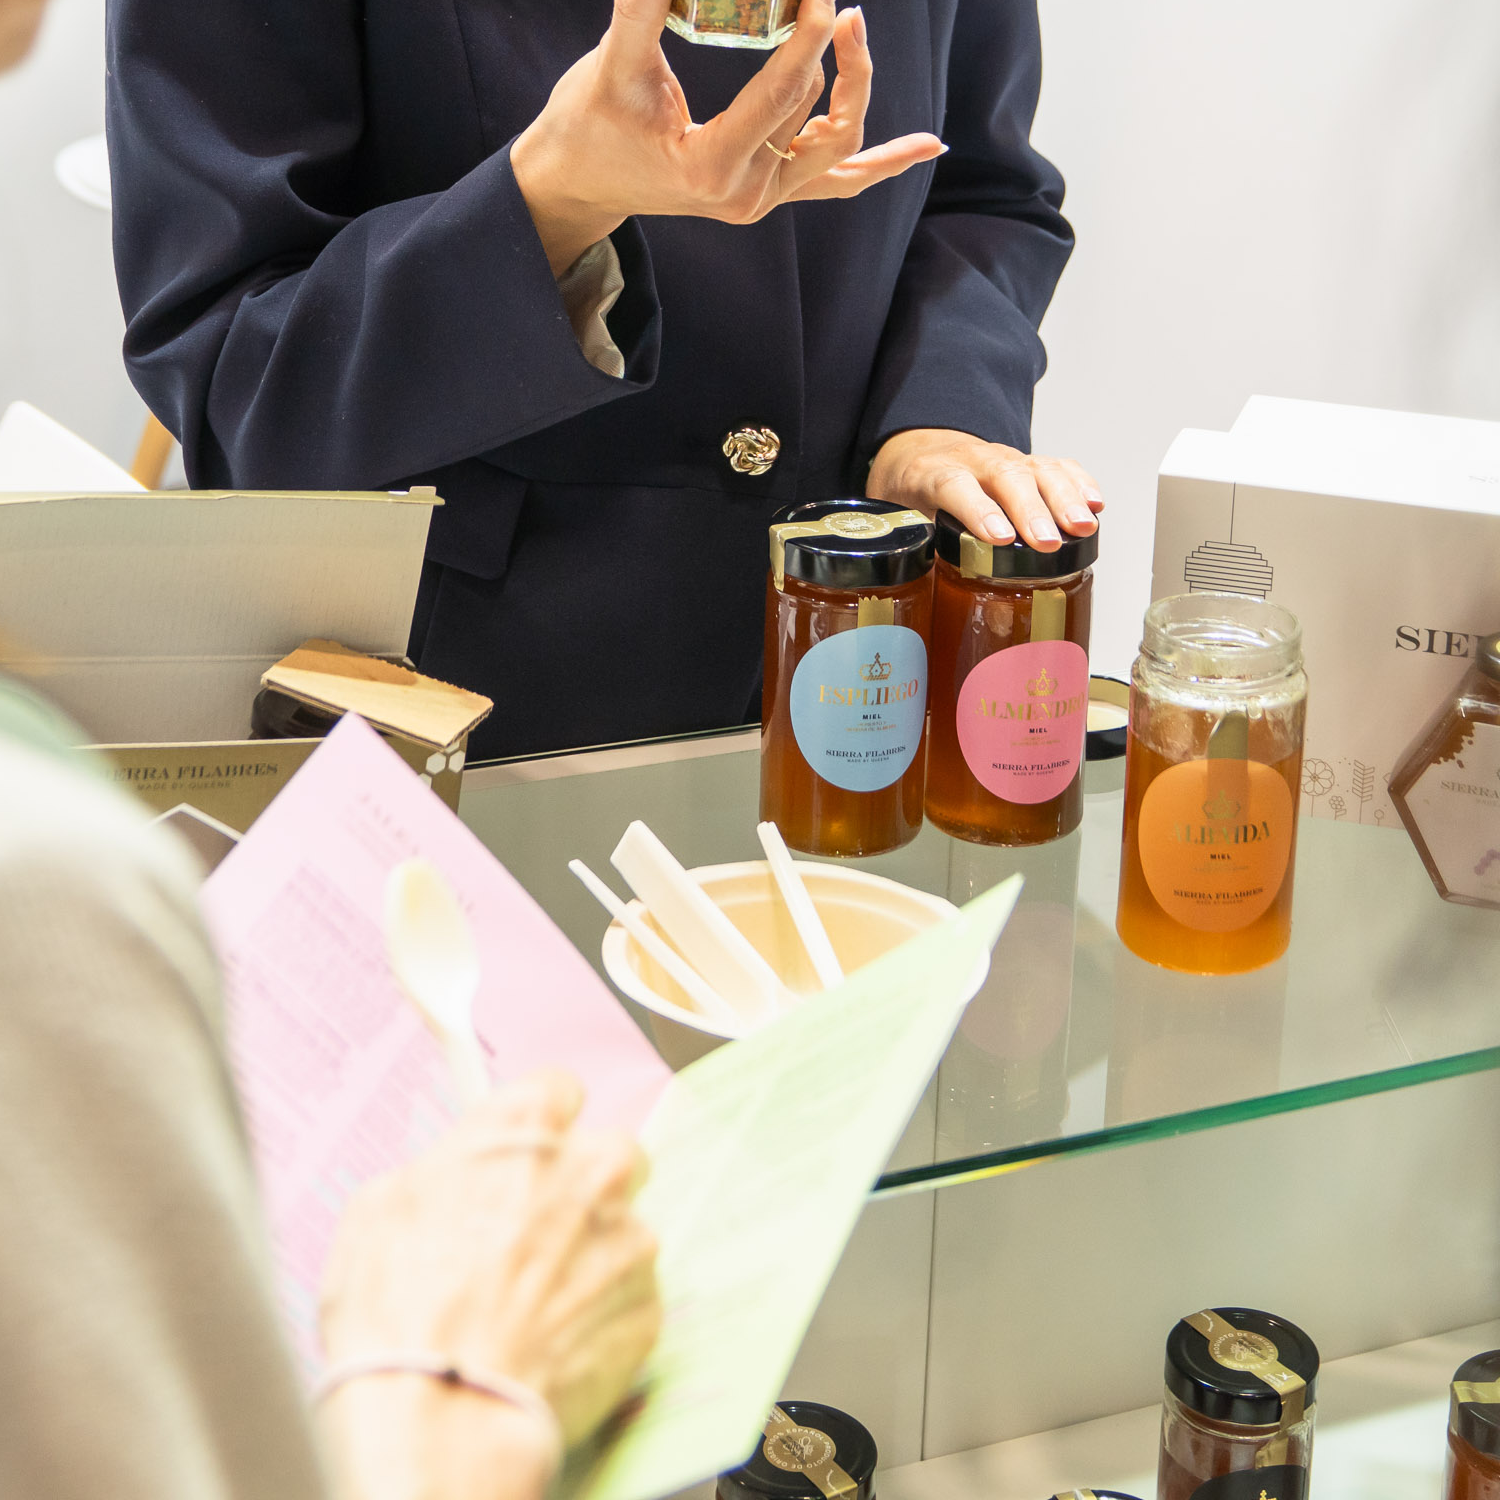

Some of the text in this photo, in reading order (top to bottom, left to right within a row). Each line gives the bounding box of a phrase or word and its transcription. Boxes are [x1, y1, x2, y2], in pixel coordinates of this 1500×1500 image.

[818, 678, 919, 707] ESPLIEGO
[974, 692, 1085, 721] ALMENDRO
[825, 744, 906, 759] SIERRA FILABRES
[176, 762, 279, 781] FILABRES
[991, 758, 1071, 772] SIERRA FILABRES
[136, 779, 232, 791] MADE BY QUEENS
[1440, 780, 1500, 800] SIERRA
[1170, 820, 1271, 845] ALBAIDA
[1209, 853, 1232, 861] MIEL
[1173, 887, 1264, 900] SIERRA FILABRES
[1213, 1332, 1235, 1359] PRODUCTO
[786, 1427, 824, 1441] ESPAÑOL
[766, 1444, 788, 1468] ORIGEN
[806, 1440, 832, 1469] PRODUCTO
